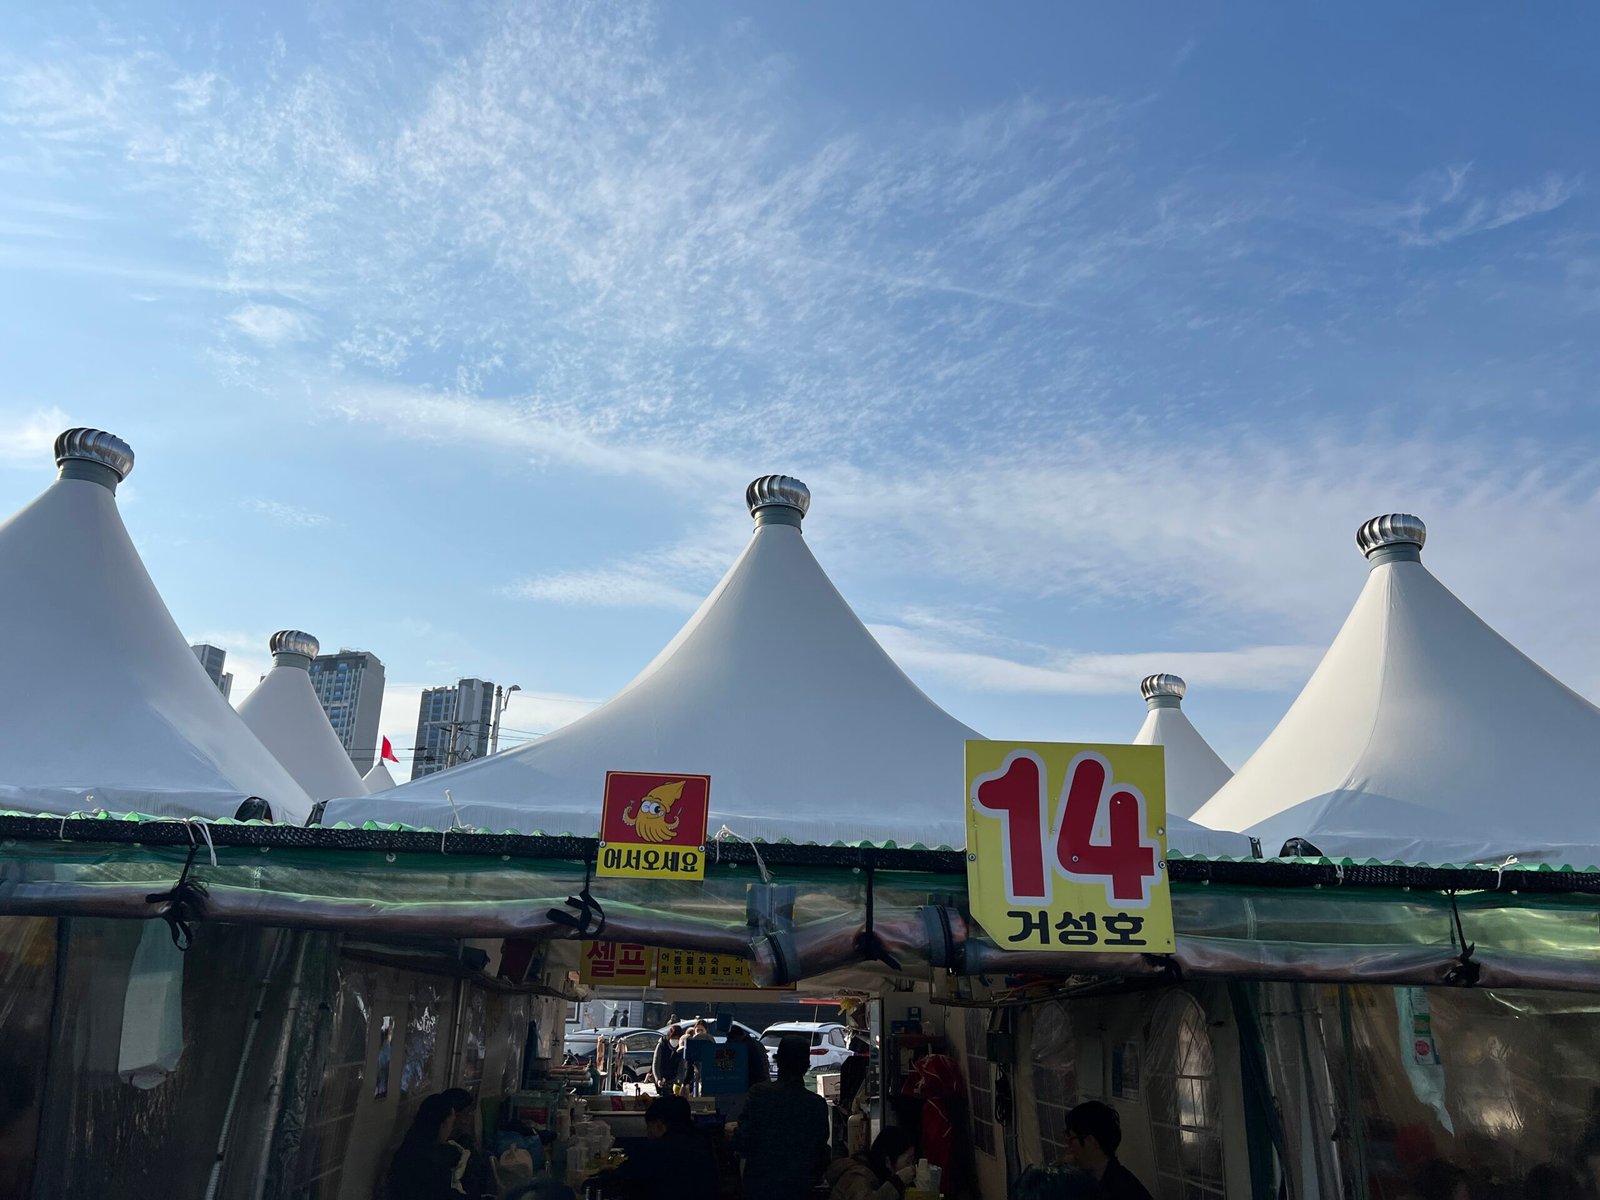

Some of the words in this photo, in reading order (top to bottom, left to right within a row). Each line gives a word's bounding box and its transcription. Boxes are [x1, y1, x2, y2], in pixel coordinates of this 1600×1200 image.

[975, 754, 1157, 902] 14
[603, 848, 698, 873] 어서오세요
[1007, 910, 1147, 946] 거성호
[587, 940, 646, 977] 셀프
